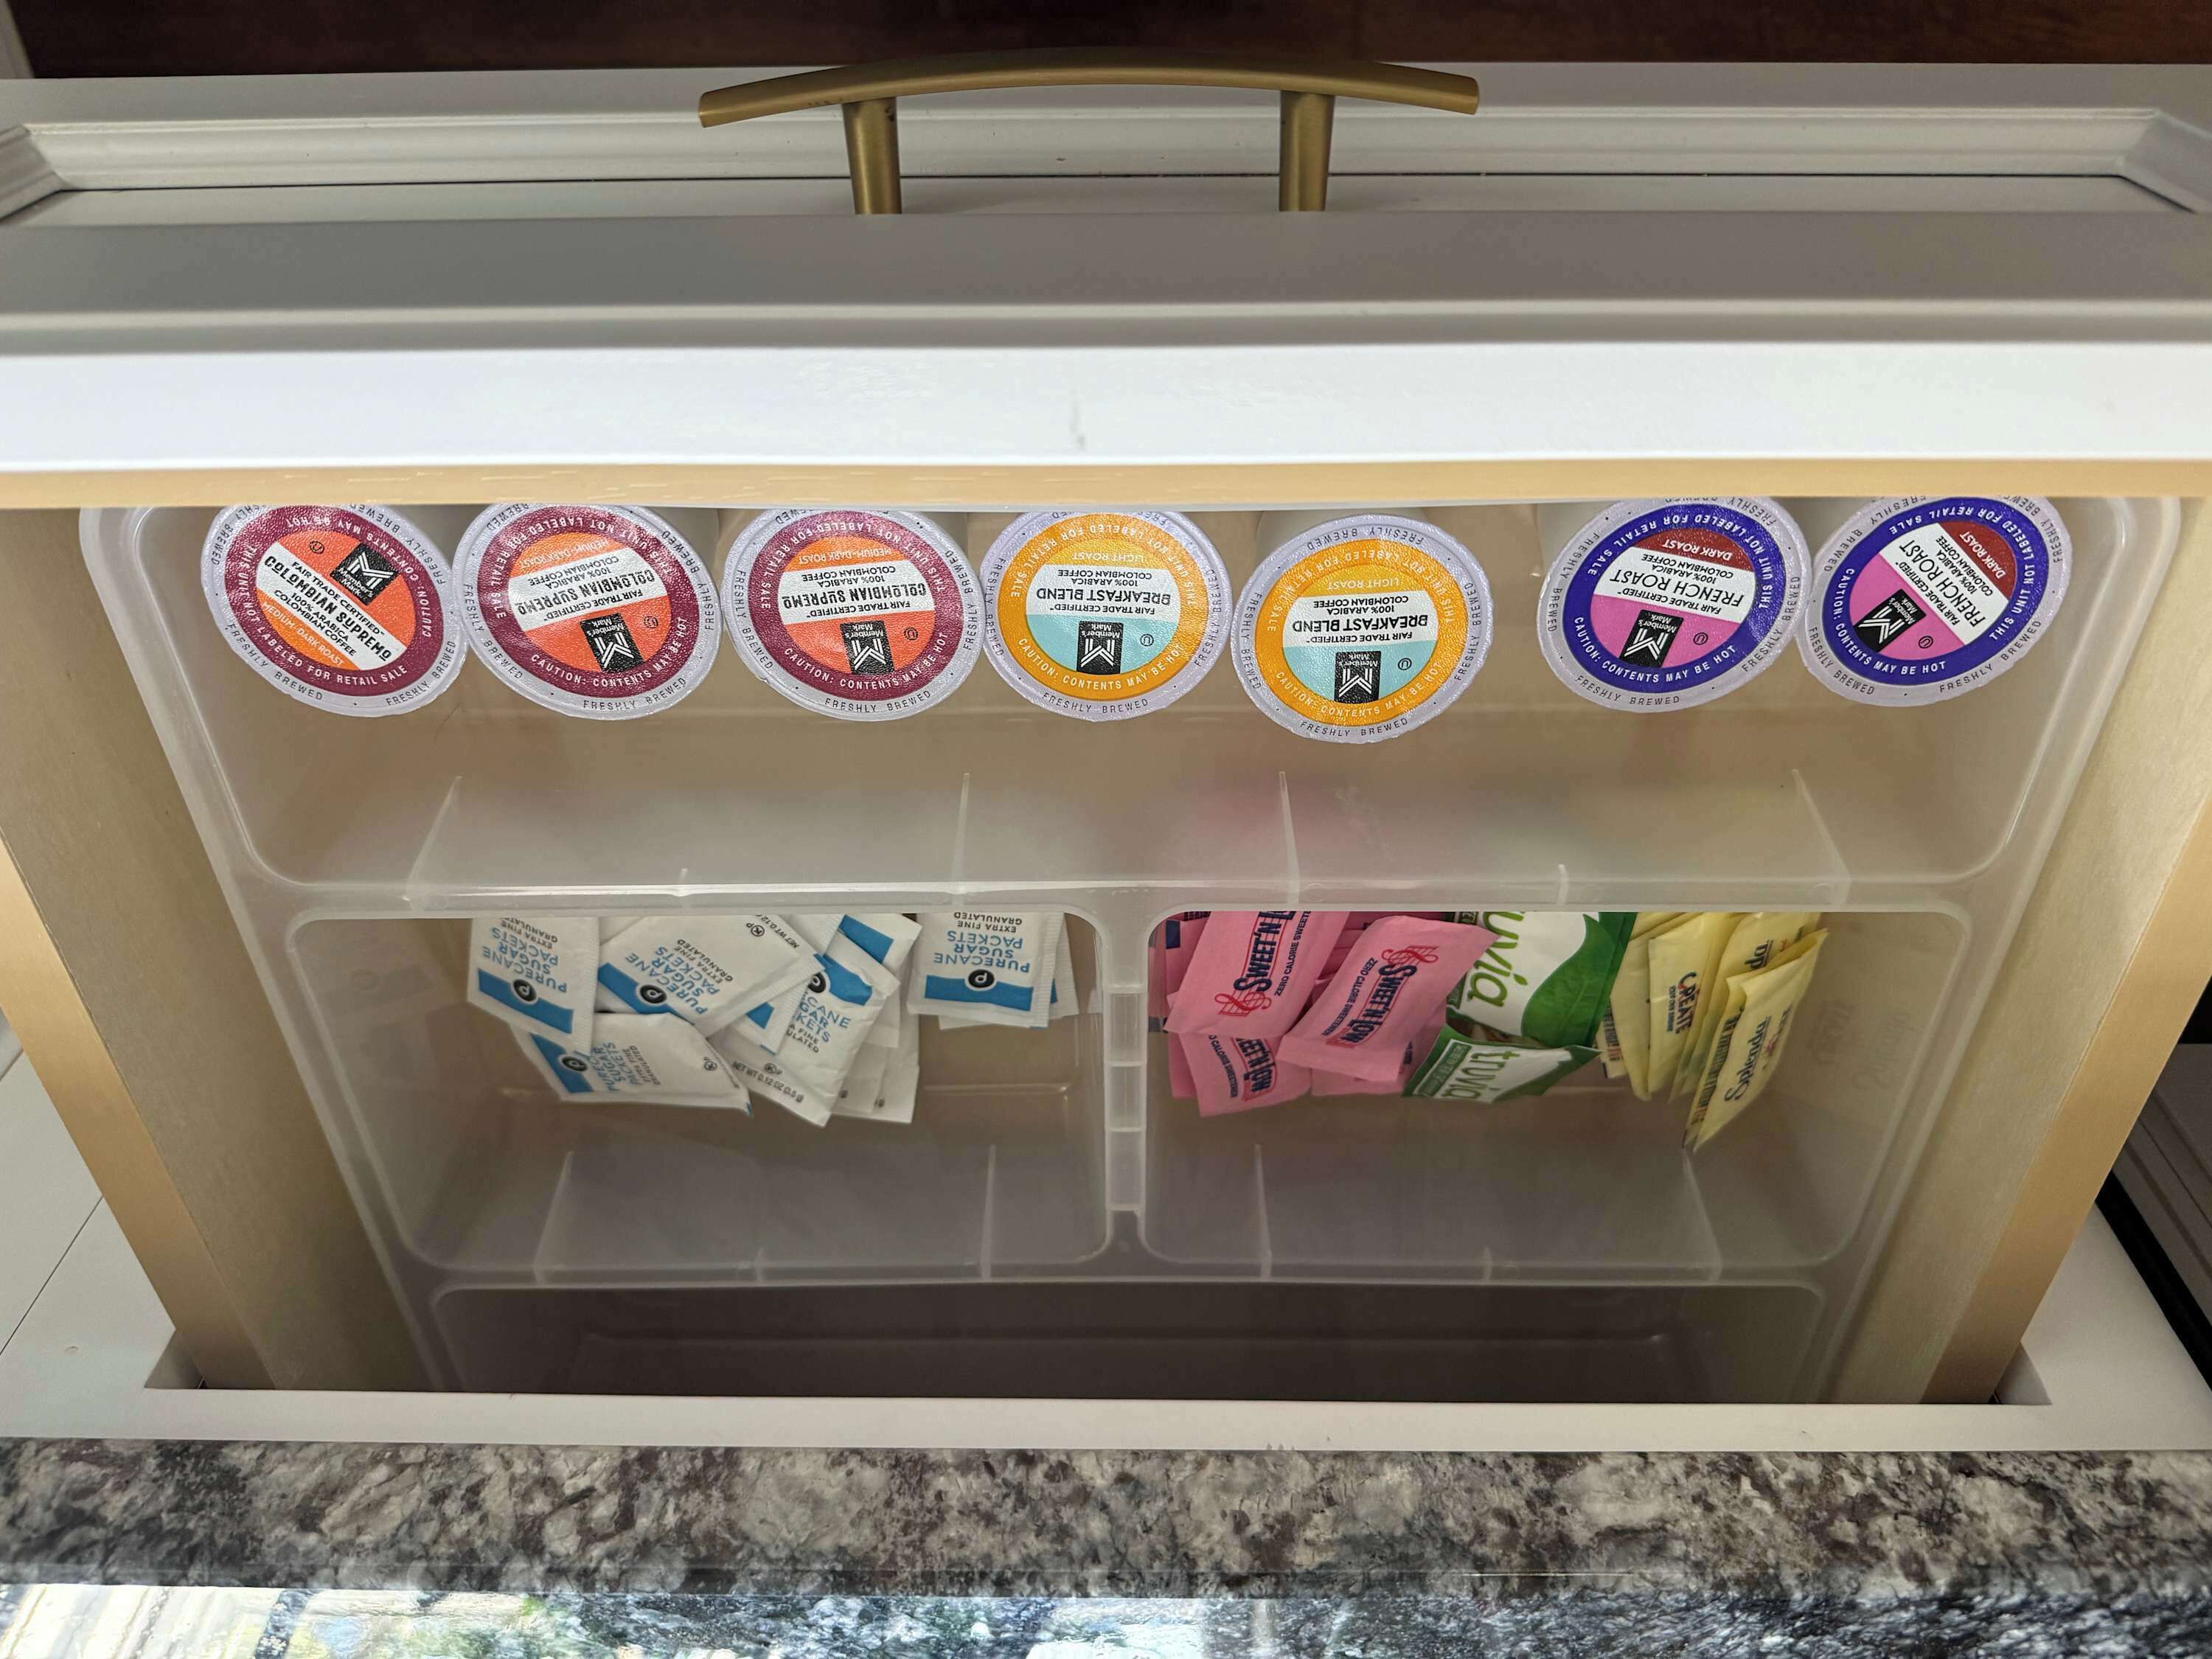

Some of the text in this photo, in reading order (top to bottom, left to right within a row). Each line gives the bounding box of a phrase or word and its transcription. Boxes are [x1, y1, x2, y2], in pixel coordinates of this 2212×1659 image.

[1307, 527, 1424, 551] FRESHLY BREWED
[1662, 539, 1732, 560] DARK ROAST
[1072, 552, 1144, 563] LIGHT ROAST
[1587, 514, 1773, 608] THIS UNIT NOT LABELED FOR RETAIL SALE
[1959, 532, 2006, 578] DARK ROAST
[527, 556, 619, 585] COLOMBIAN COFFEE
[801, 566, 896, 582] COLOMBIAN COFFEE
[1096, 571, 1152, 580] COLOMBIAN
[1641, 554, 1733, 579] COLOMBIAN COFFEE
[1652, 565, 1716, 584] 100% ARABICA
[1888, 507, 2035, 639] THIS UNIT NOT LABELED FOR RETAIL SALE
[1935, 536, 1993, 596] COLOMBIAN COFFEE
[1936, 550, 1977, 594] 100% ARABICA
[292, 562, 312, 579] FAIR
[312, 577, 338, 601] TRADE
[339, 568, 374, 597] Member's
[341, 577, 362, 597] Mark
[546, 567, 611, 589] 100% ARABICA
[817, 577, 858, 588] ARABICA
[1327, 578, 1399, 590] LIGHT ROAST
[1610, 570, 1743, 607] FRENCH ROAST
[1899, 540, 1986, 627] FRENCH ROAST
[515, 569, 655, 615] COLOMBIAN SUPREMO
[592, 594, 622, 606] TRADE
[622, 589, 642, 599] FAIR
[782, 583, 926, 609] COLOMBIAN SUPREMO
[1037, 588, 1170, 605] BREAKFAST BLEND
[1352, 596, 1408, 605] COLOMBIAN
[1927, 591, 1947, 612] TRADE
[265, 556, 392, 661] COLOMBIAN SUPREMO
[858, 603, 889, 612] TRADE
[1327, 605, 1394, 615] 100% ARABICA
[1669, 598, 1699, 610] TRADE
[1701, 604, 1721, 614] FAIR
[1889, 597, 1916, 625] Member's
[1902, 598, 1918, 613] Mark
[274, 590, 357, 655] COLOMBIAN COFFEE
[292, 593, 349, 640] 100% ARABICA
[592, 619, 611, 628] Mark
[1292, 615, 1427, 632] BREAKFAST BLEND
[1638, 619, 1677, 633] Member's
[1650, 615, 1672, 624] Mark
[1833, 568, 1945, 675] CAUTION: CONTENTS MAY BE HOT
[1944, 607, 1961, 625] FAIR
[586, 623, 625, 636] Member's
[845, 630, 883, 639] Member's
[1360, 633, 1390, 641] TRADE
[1602, 660, 1659, 682] CONTENTS
[1665, 669, 1688, 683] MAY
[1694, 661, 1710, 674] BE
[1713, 645, 1735, 667] HOT
[954, 911, 1022, 925] GRANULATED
[958, 920, 1016, 933] EXTRA FINE
[501, 919, 553, 949] EXTRA FINE
[773, 926, 787, 939] WT
[785, 934, 799, 949] NET
[947, 931, 1023, 949] PACKETS
[490, 927, 558, 967] PACKETS
[954, 944, 1013, 958] SUGAR
[482, 945, 567, 993] PURECANE
[498, 942, 551, 975] SUGAR
[675, 946, 723, 984] EXTRA FINE
[677, 939, 733, 982] GRANULATED
[933, 953, 1029, 973] PURECANE
[1274, 975, 1289, 996] ZERO
[1284, 942, 1298, 975] CALORIE
[651, 957, 704, 998] SUGAR
[655, 946, 720, 995] PACKETS
[625, 952, 707, 1015] PURECANE
[1321, 957, 1378, 1036] ZERO CALORIE SWEETENER
[1724, 1017, 1770, 1102] Splenda
